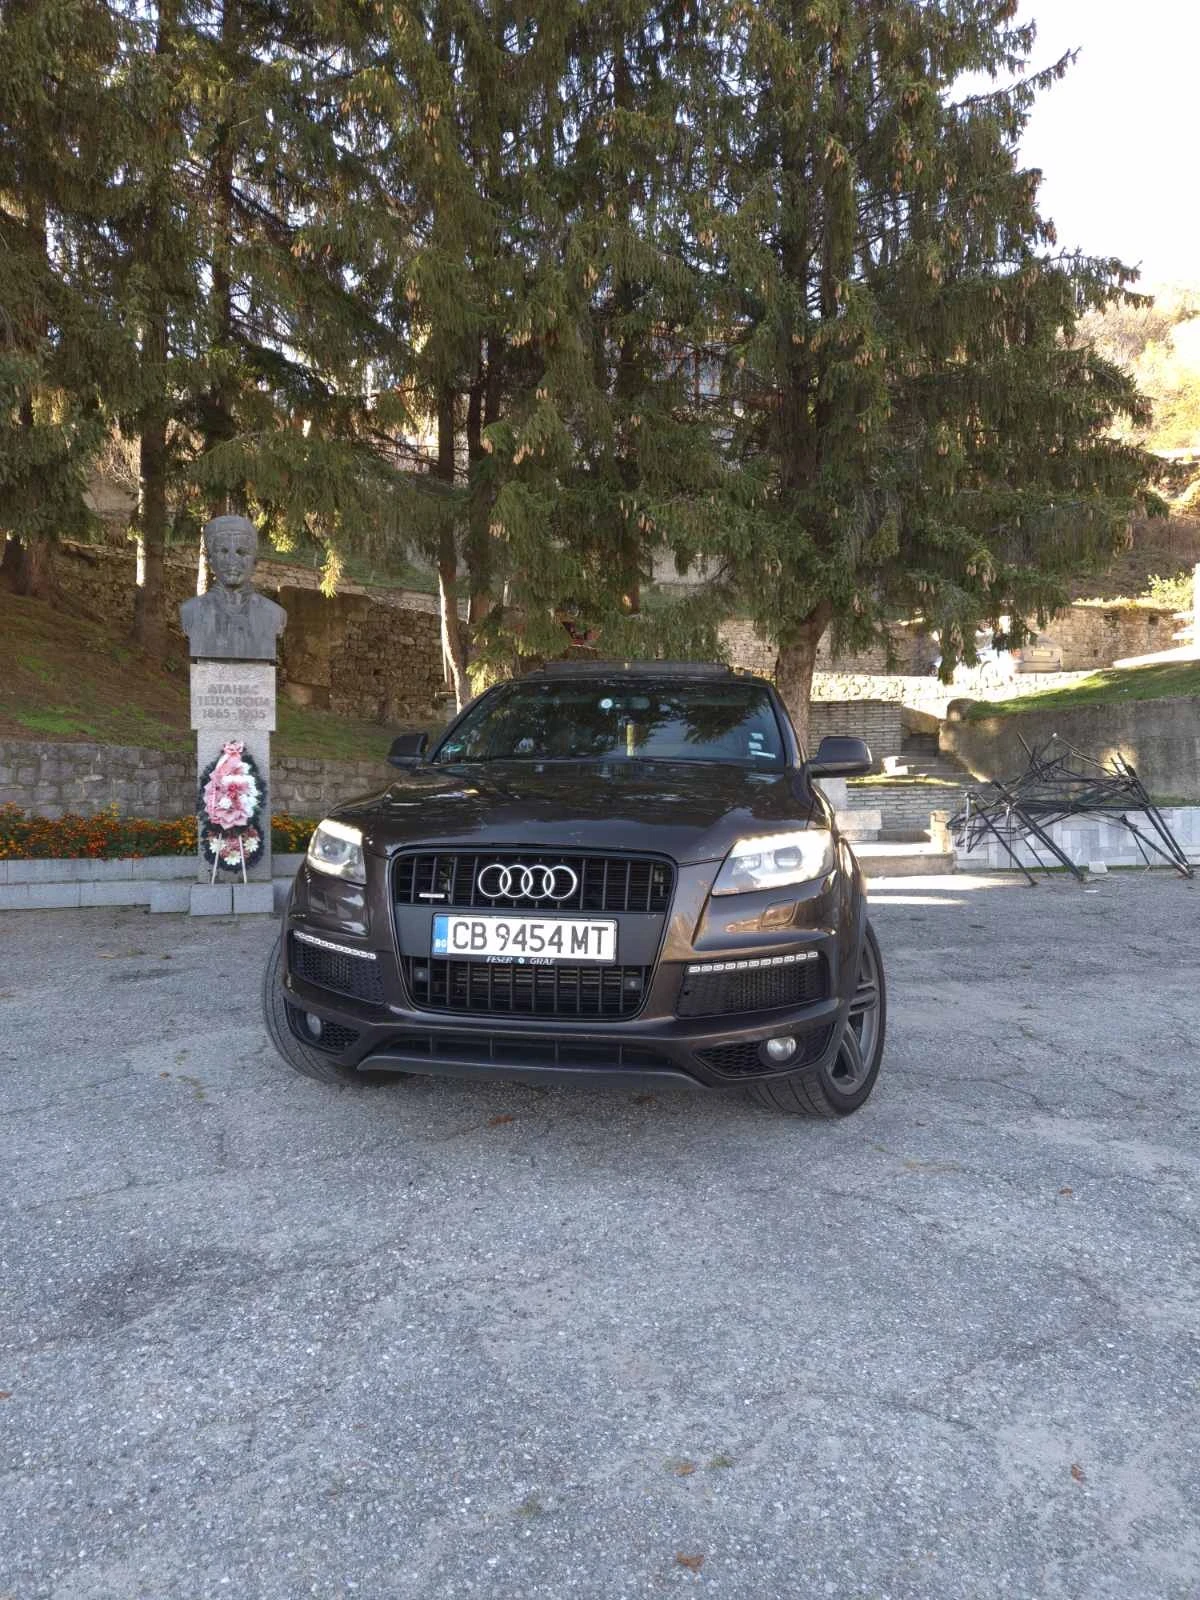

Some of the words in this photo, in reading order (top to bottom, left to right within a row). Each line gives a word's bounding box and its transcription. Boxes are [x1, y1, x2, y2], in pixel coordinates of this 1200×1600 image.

[453, 921, 488, 950] CB
[495, 923, 563, 954] 9454
[570, 926, 609, 955] MT
[529, 957, 555, 965] GRAF
